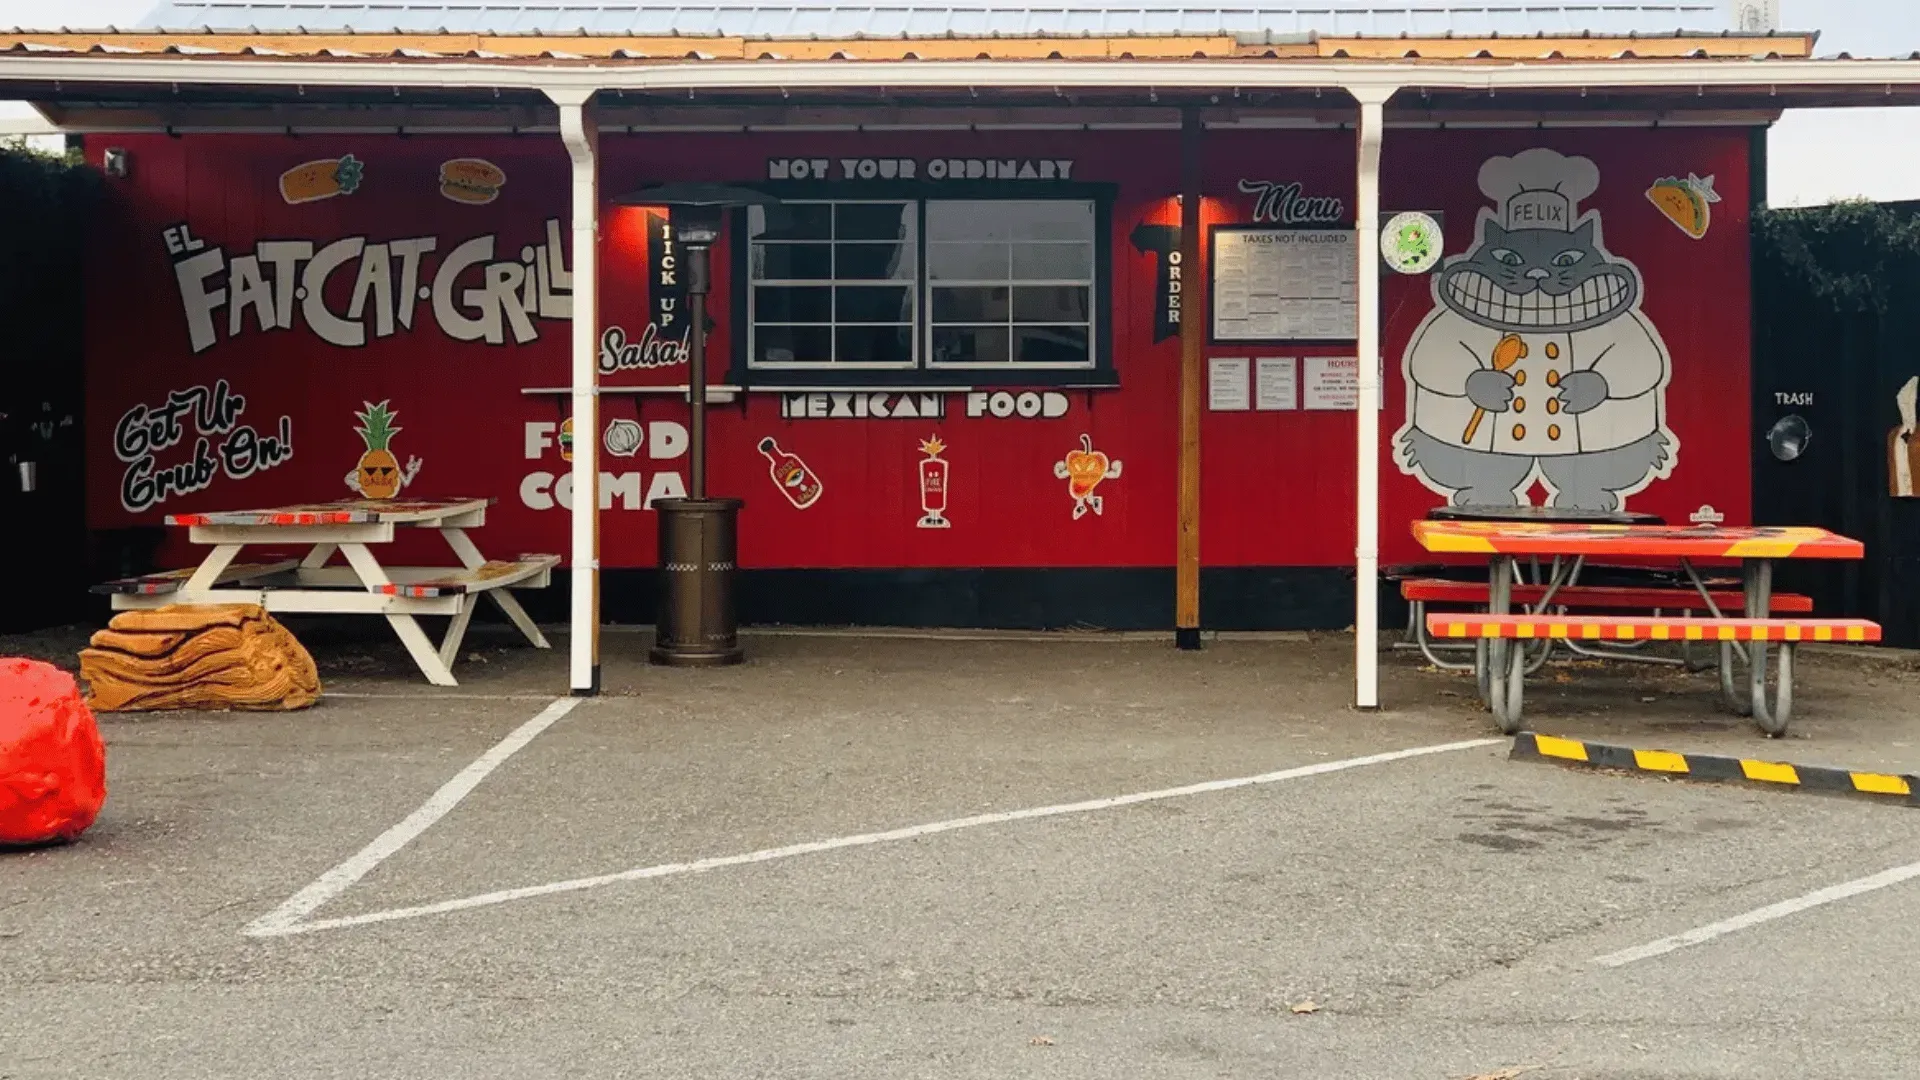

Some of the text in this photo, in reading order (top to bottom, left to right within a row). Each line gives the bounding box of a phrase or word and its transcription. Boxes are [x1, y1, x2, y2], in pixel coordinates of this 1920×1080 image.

[769, 159, 1074, 179] NOT YOUR ORDINARY
[1238, 178, 1345, 224] Menu
[1514, 203, 1562, 222] FELIX
[162, 224, 204, 255] EL
[1242, 234, 1348, 244] TAXES NOT INCLUDED
[1168, 250, 1183, 323] ORDER
[660, 298, 676, 328] UP
[780, 391, 1070, 418] MEXICAN FOOD
[1774, 391, 1814, 406] TRASH
[114, 378, 246, 462] Get Ur
[120, 415, 293, 513] Grub On!
